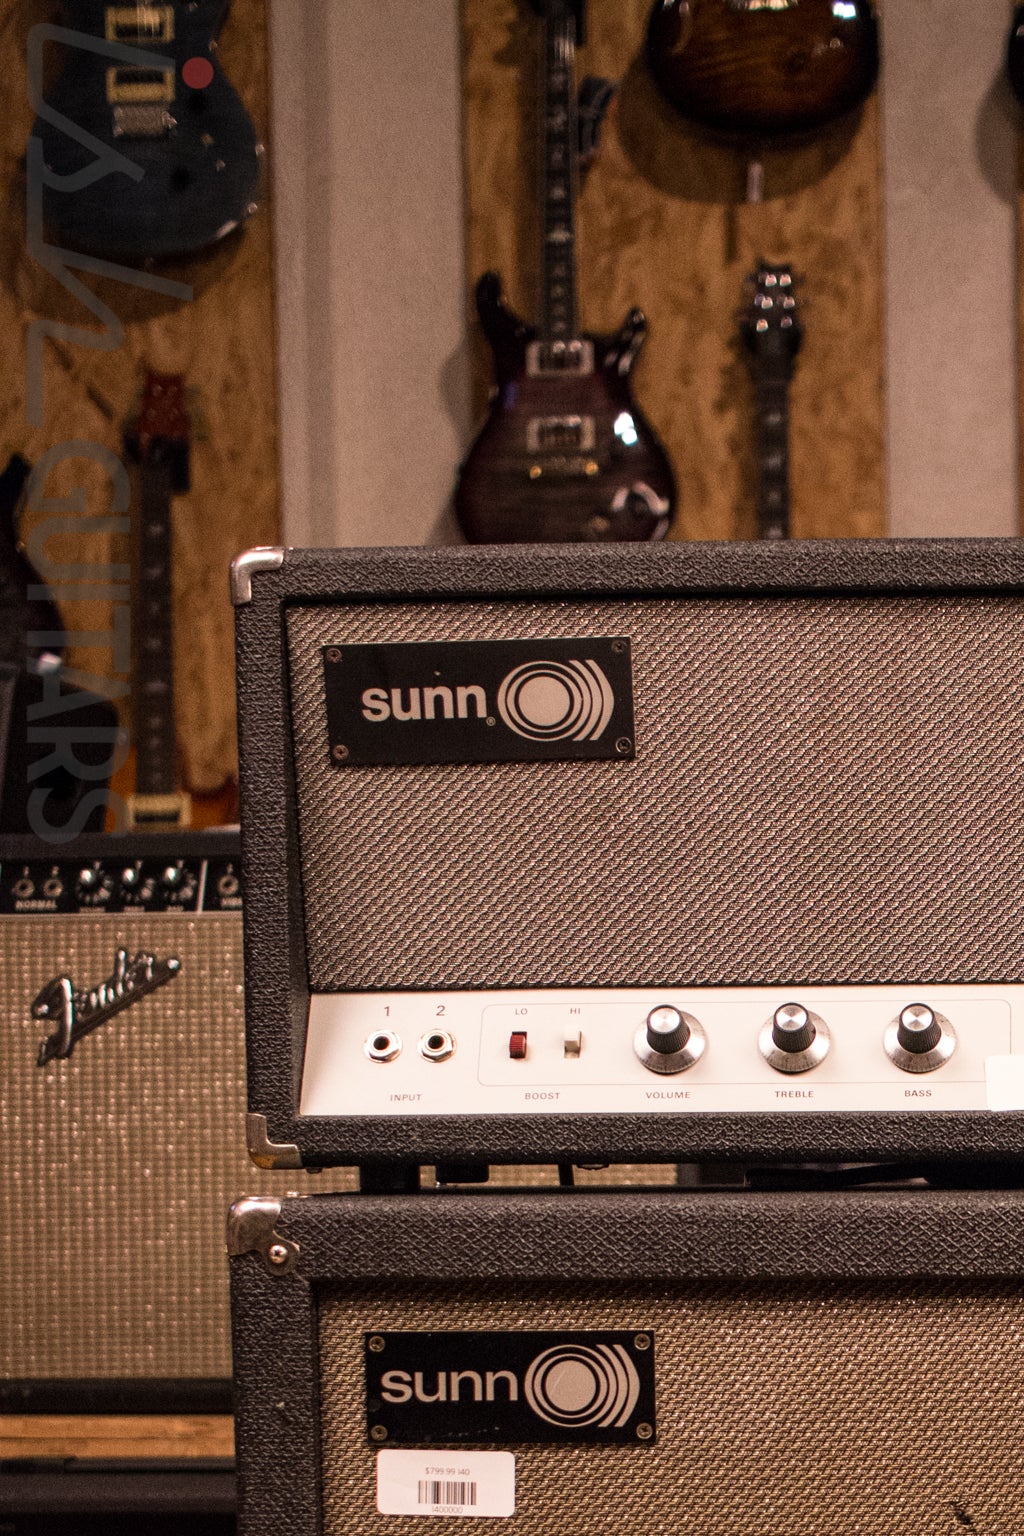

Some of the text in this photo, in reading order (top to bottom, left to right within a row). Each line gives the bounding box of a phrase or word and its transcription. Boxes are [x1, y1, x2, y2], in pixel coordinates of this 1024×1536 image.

[14, 900, 58, 911] NORMAL
[30, 947, 182, 1067] Fender
[384, 1006, 391, 1017] 1
[436, 1005, 446, 1017] 2
[570, 1007, 581, 1015] HI
[525, 1092, 560, 1100] BOOST
[645, 1091, 692, 1099] VOLUME
[774, 1090, 814, 1098] TREBLE
[380, 1369, 519, 1403] sunn
